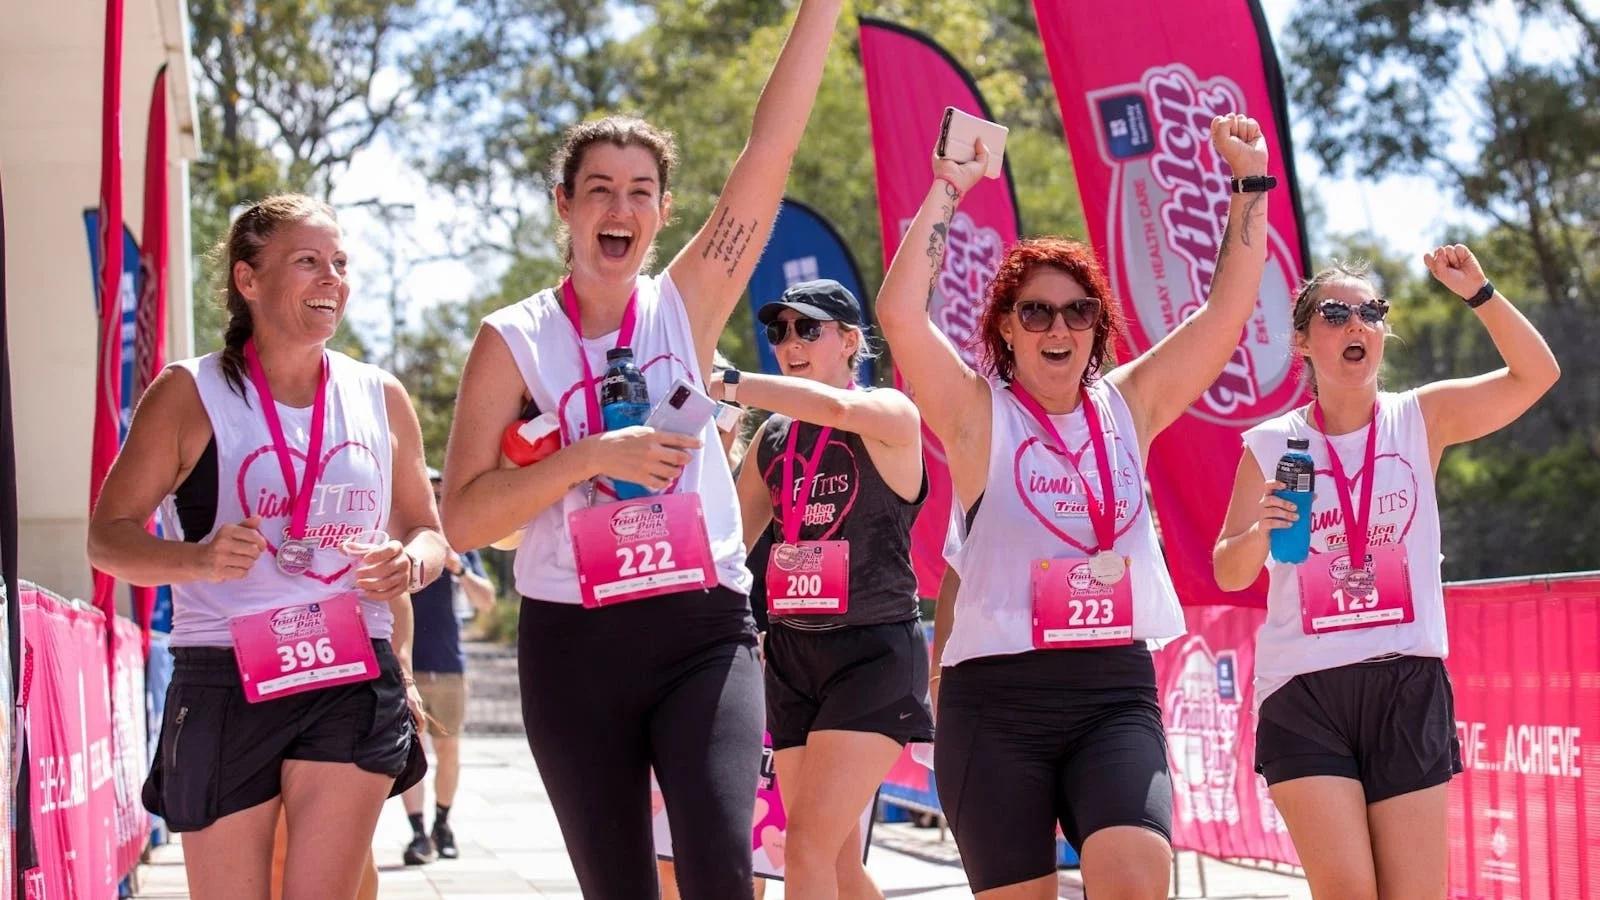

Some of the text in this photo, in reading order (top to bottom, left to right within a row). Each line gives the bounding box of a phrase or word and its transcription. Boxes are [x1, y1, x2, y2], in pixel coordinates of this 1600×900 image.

[1134, 179, 1151, 218] CARE
[1144, 223, 1165, 279] HEALTH
[1056, 500, 1128, 512] Trian
[1311, 490, 1408, 533] am ITS
[284, 523, 363, 540] iathlon
[1327, 525, 1395, 545] Trilon
[1366, 534, 1391, 547] ink
[616, 541, 676, 577] 222
[786, 575, 822, 597] 200
[1068, 599, 1114, 626] 223
[277, 637, 336, 672] 396
